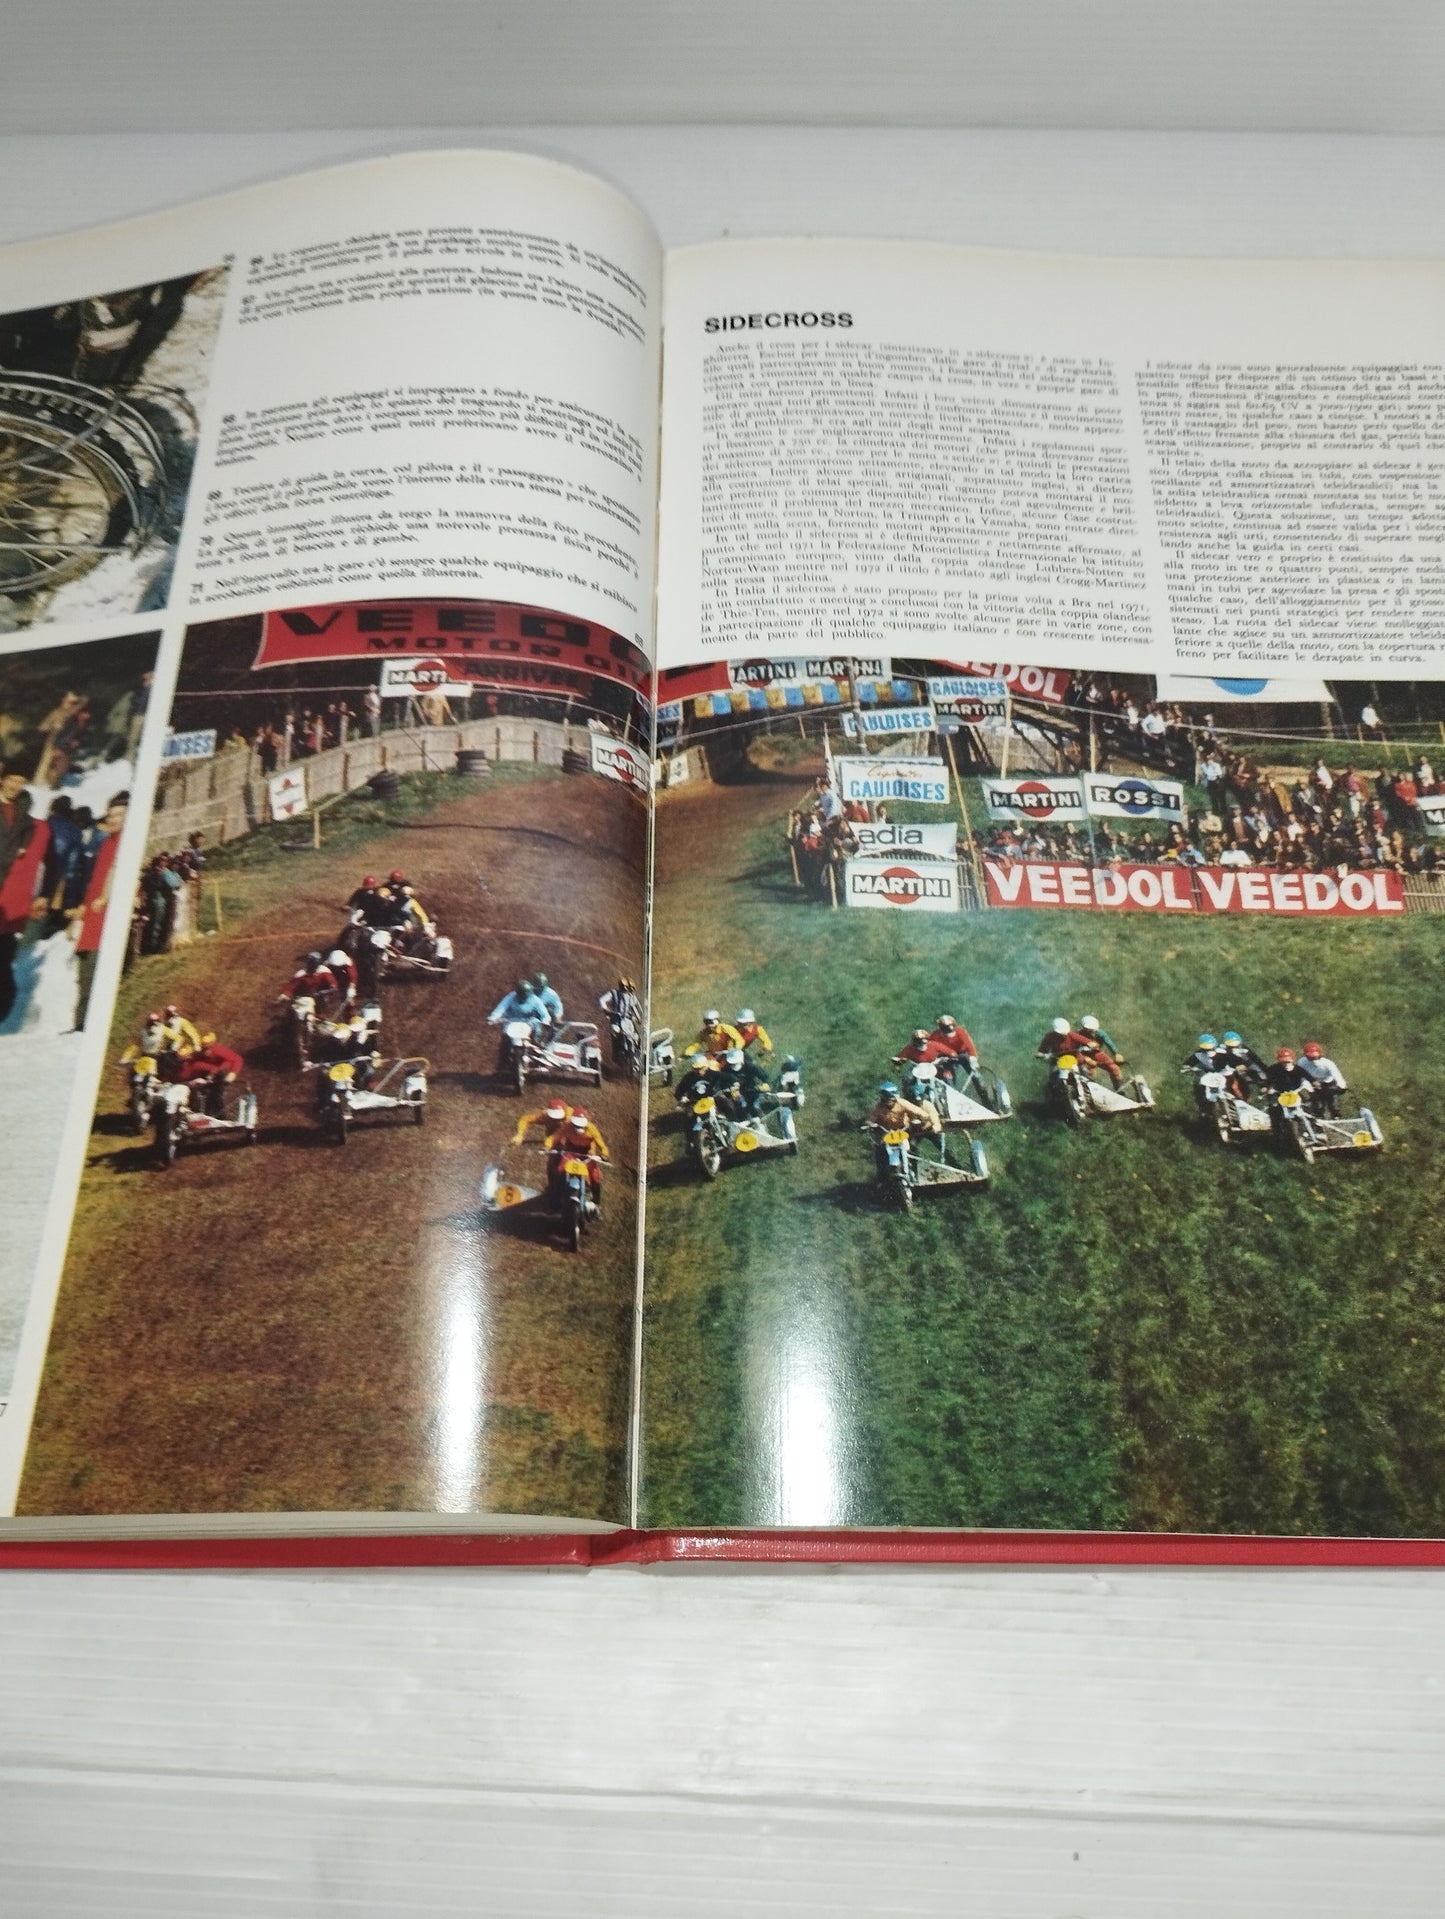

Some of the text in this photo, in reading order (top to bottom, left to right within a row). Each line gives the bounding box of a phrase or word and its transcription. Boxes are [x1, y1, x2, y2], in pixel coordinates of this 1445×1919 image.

[704, 312, 854, 334] SIDECROSS
[368, 637, 561, 658] MOTOR
[700, 629, 884, 645] mento da parte del pubblico.
[936, 702, 1005, 717] MARTINI
[850, 779, 945, 801] GAULOISES
[991, 792, 1082, 809] MARTINI
[1092, 787, 1180, 809] ROSSI
[859, 826, 923, 845] adia
[853, 875, 951, 898] MARTINI
[984, 861, 1193, 909] VEEDOL
[1197, 871, 1404, 911] VEEDOL
